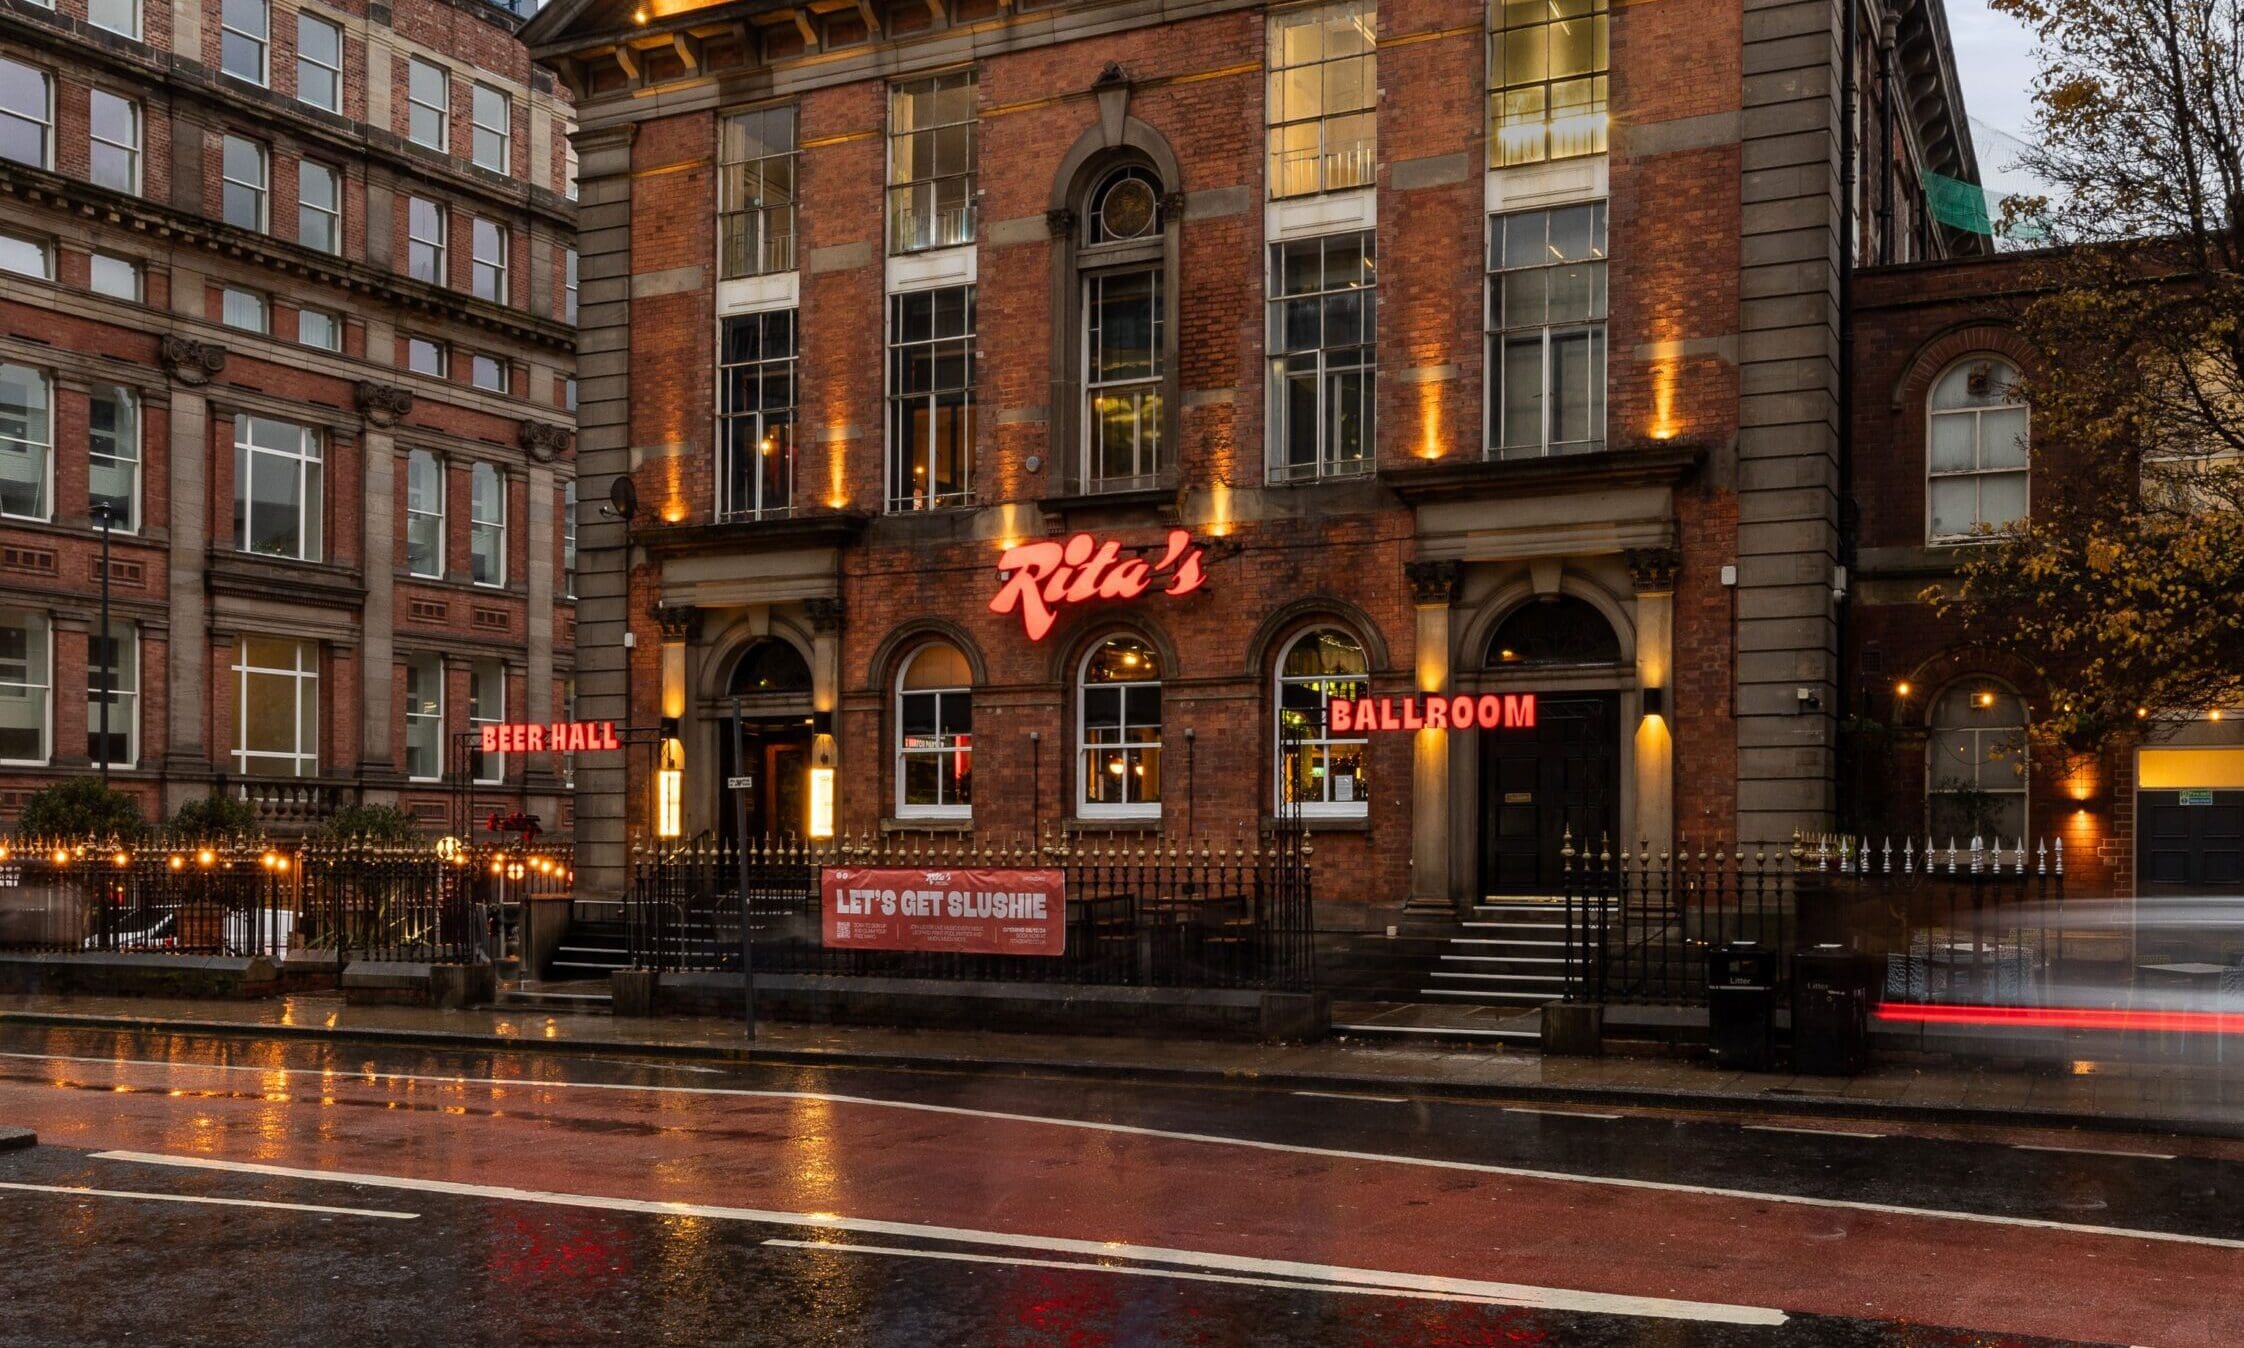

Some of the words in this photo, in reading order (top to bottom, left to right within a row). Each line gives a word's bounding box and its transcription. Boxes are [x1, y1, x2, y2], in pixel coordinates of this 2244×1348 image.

[988, 530, 1208, 642] Rita's
[1331, 694, 1536, 731] BALLROOM
[482, 724, 546, 752] BEER
[550, 721, 621, 751] HALL
[836, 889, 897, 916] LET'S
[901, 890, 944, 917] GET
[947, 891, 1048, 919] SLUSHIE
[1730, 977, 1751, 985] Litter
